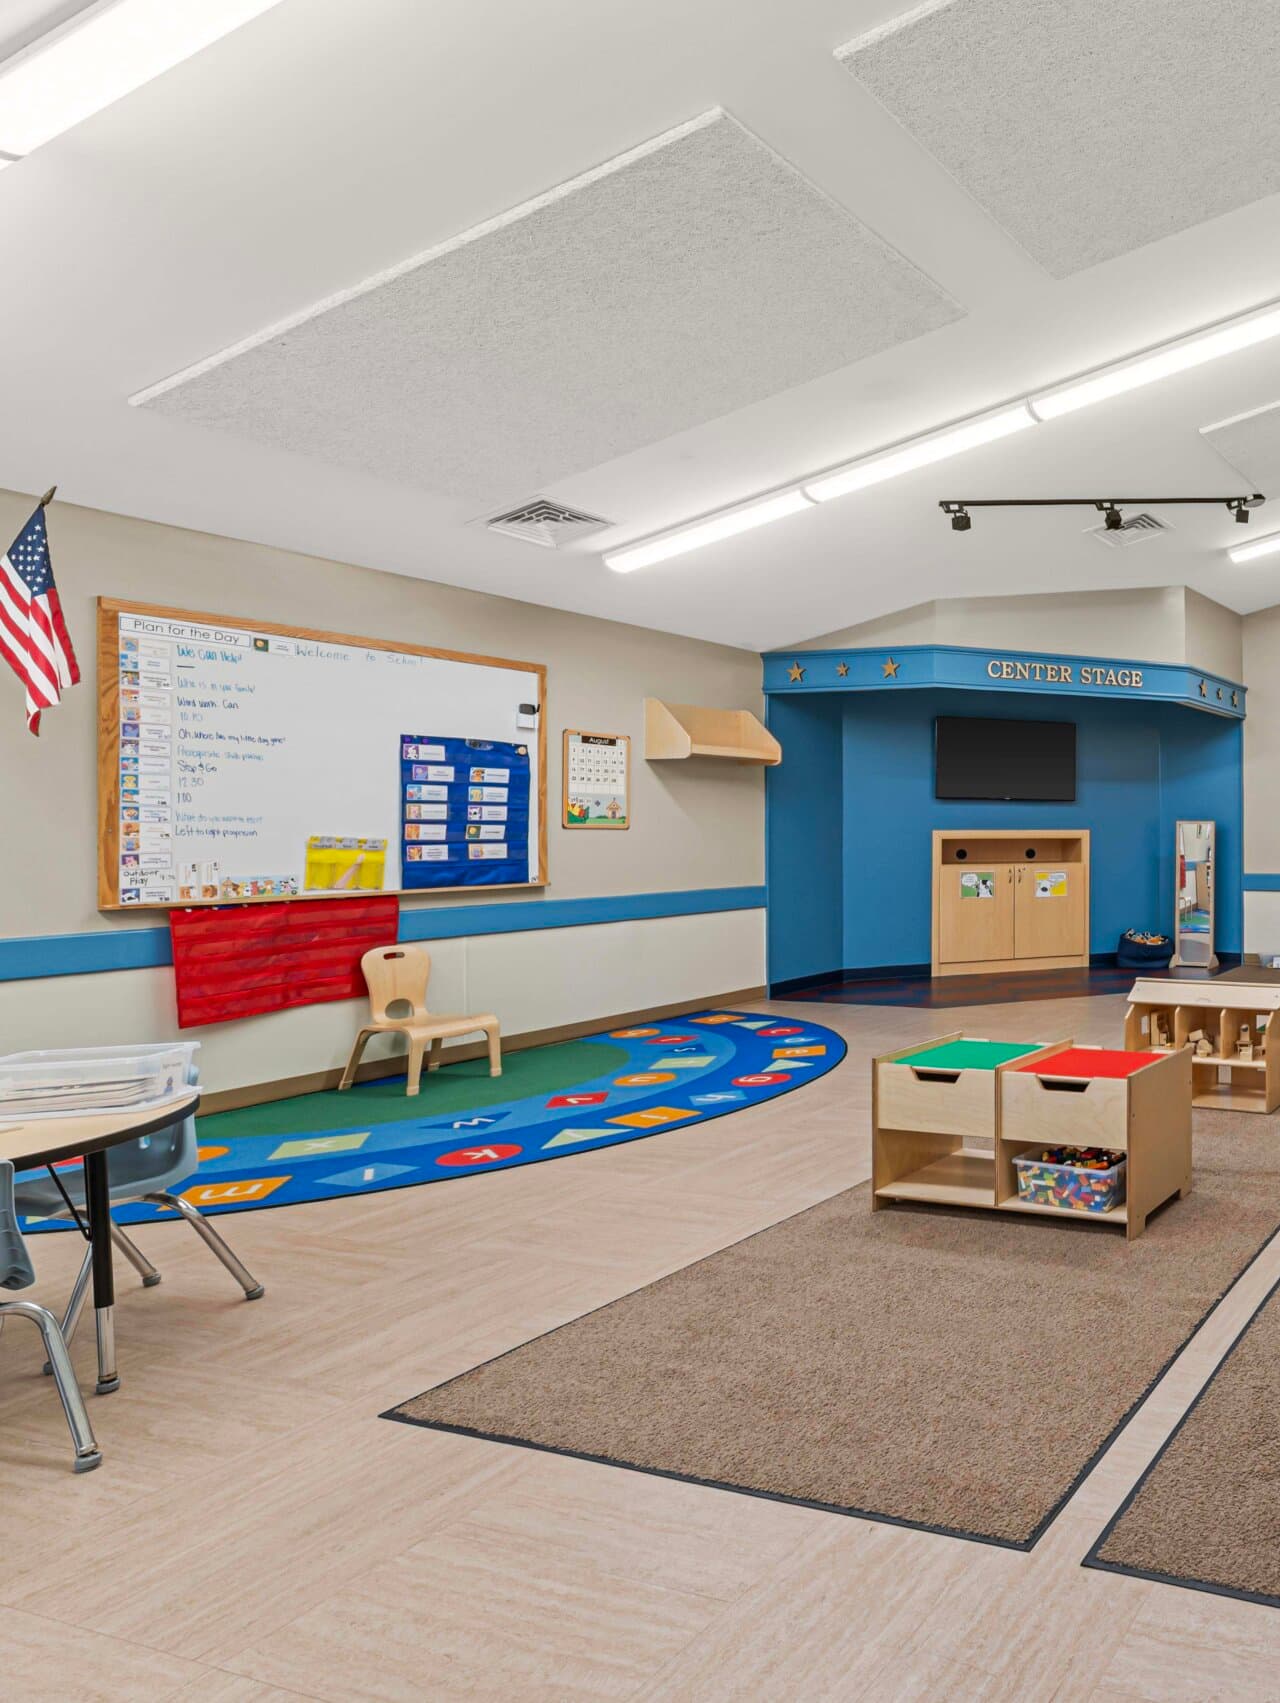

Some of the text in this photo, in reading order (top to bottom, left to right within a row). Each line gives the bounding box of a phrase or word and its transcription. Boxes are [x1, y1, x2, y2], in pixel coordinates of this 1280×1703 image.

[134, 620, 240, 644] Plan for the Day
[296, 644, 352, 661] Welcome
[987, 660, 1143, 687] CENTER STAGE
